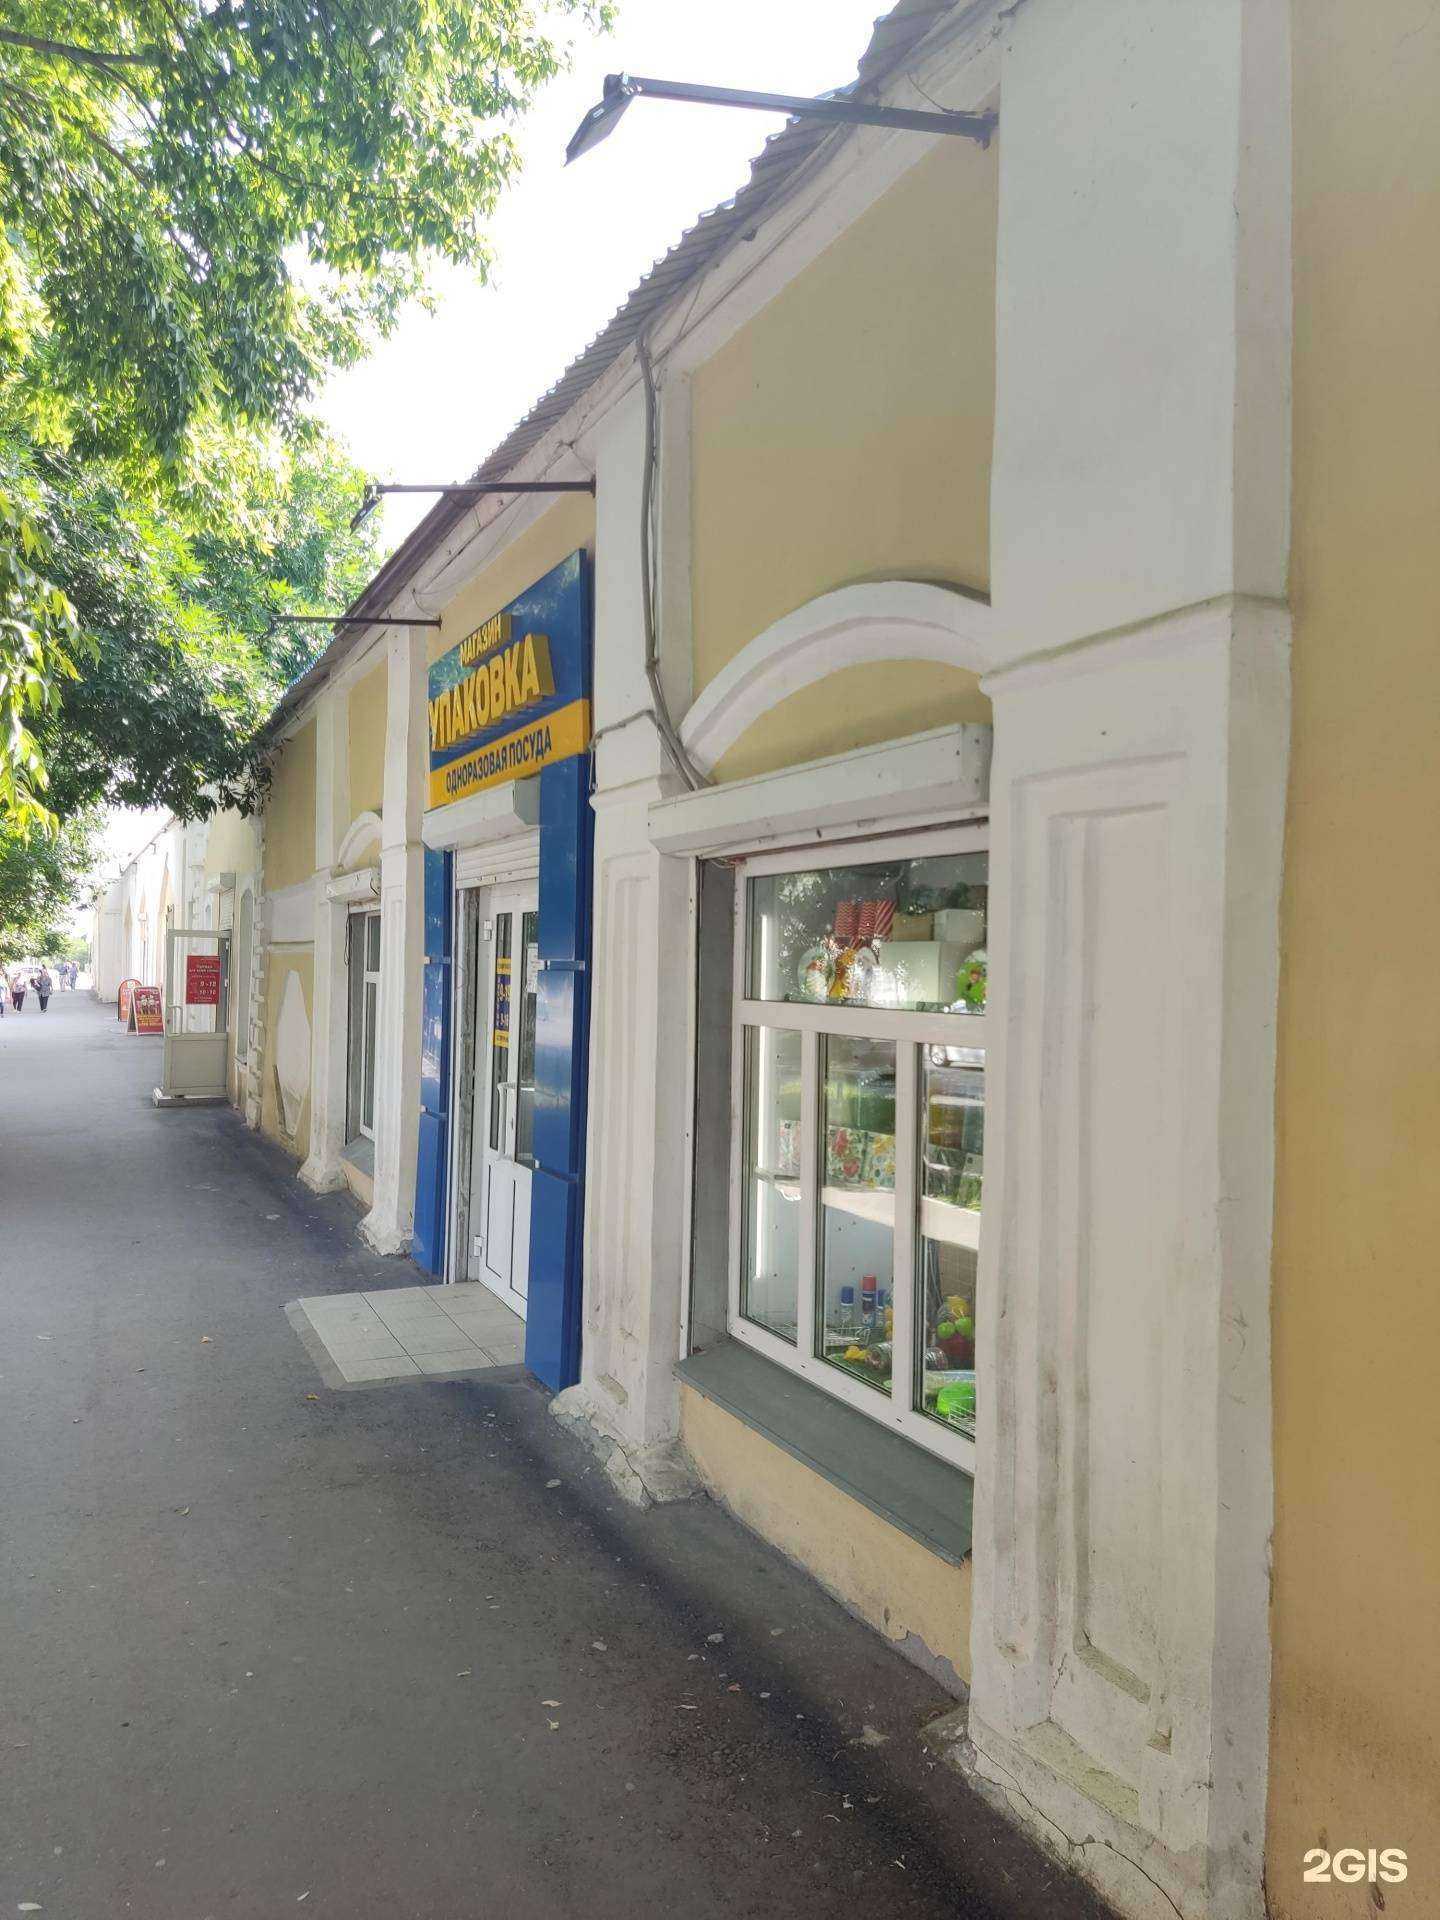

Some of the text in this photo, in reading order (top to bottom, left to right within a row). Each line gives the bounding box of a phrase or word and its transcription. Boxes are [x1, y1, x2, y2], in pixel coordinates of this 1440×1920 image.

[460, 614, 501, 667] МАГАЗИН
[428, 633, 540, 751] УПАКОВКА
[446, 726, 552, 796] ОДНОРАЗОВАЯ ПОСУДА
